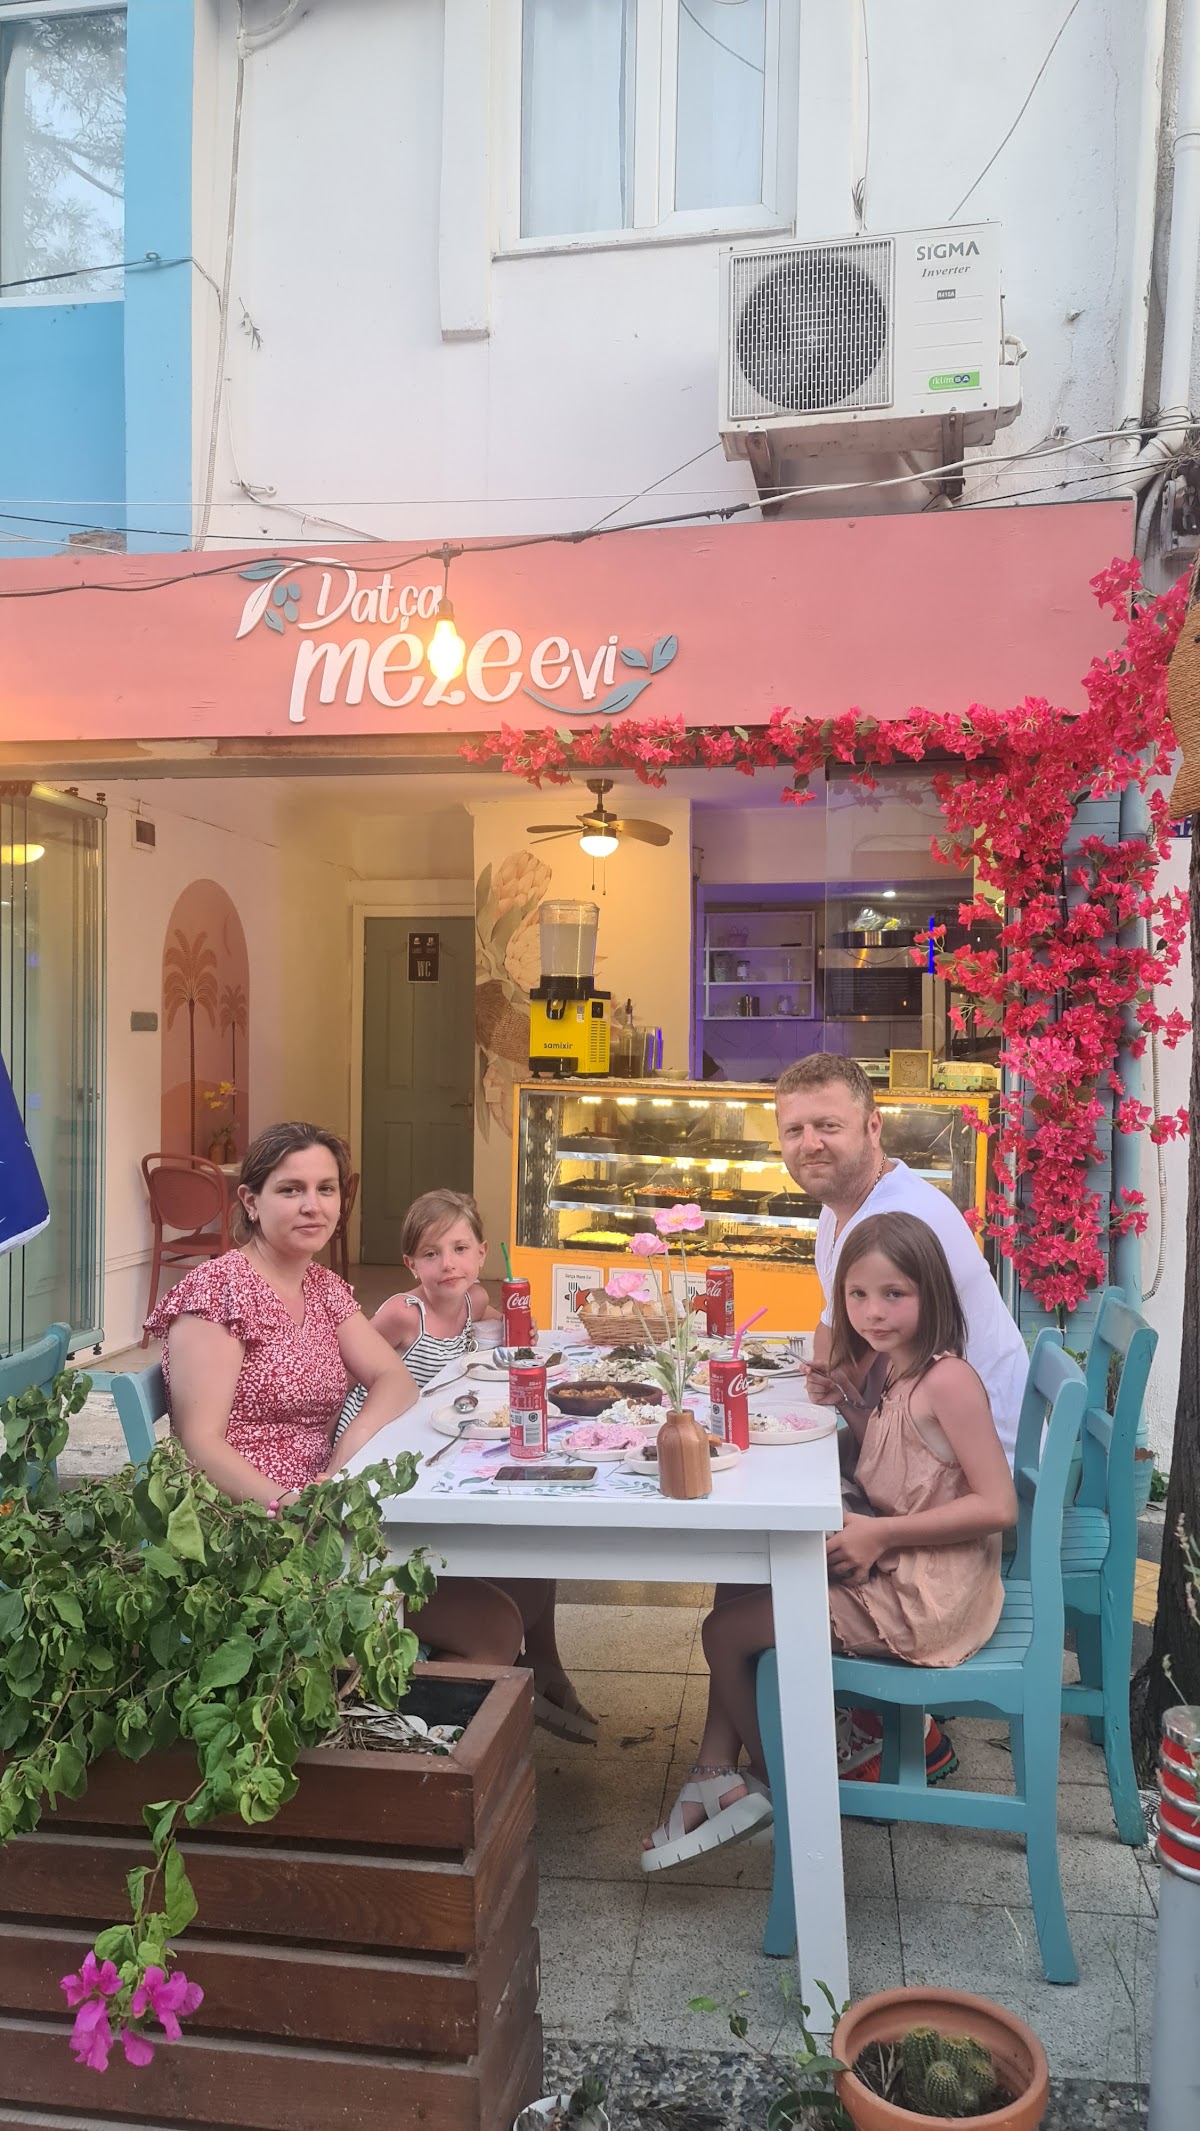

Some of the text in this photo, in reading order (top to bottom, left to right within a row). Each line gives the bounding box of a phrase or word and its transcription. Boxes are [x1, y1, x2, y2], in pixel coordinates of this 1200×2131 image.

[916, 240, 980, 261] SIGMA
[921, 265, 971, 278] Inverter
[289, 557, 443, 632] Datça
[530, 635, 618, 700] evi
[417, 960, 431, 977] WC
